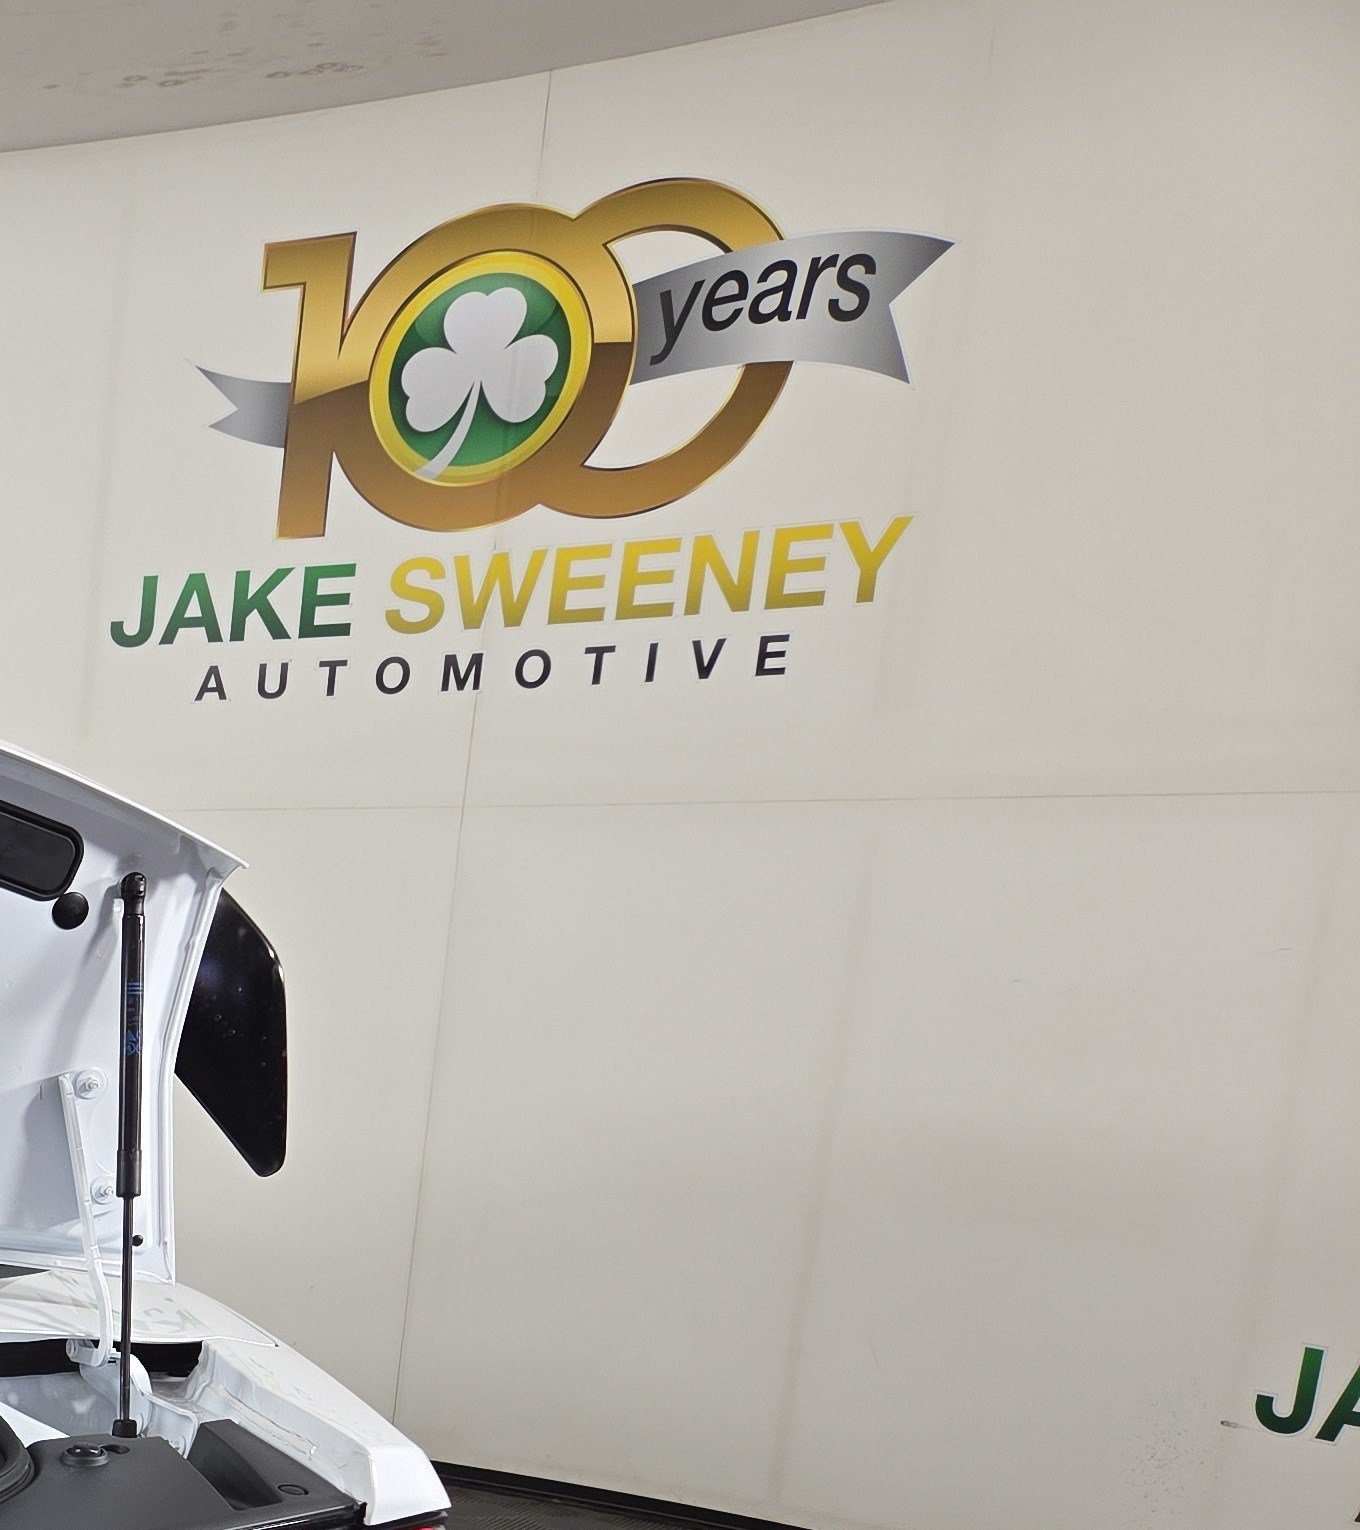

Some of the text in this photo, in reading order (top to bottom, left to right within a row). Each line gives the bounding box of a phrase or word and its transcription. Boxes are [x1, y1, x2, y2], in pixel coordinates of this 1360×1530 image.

[649, 253, 877, 365] years
[109, 515, 915, 649] JAKE SWEENEY
[194, 633, 792, 703] AUTOMOTIVE
